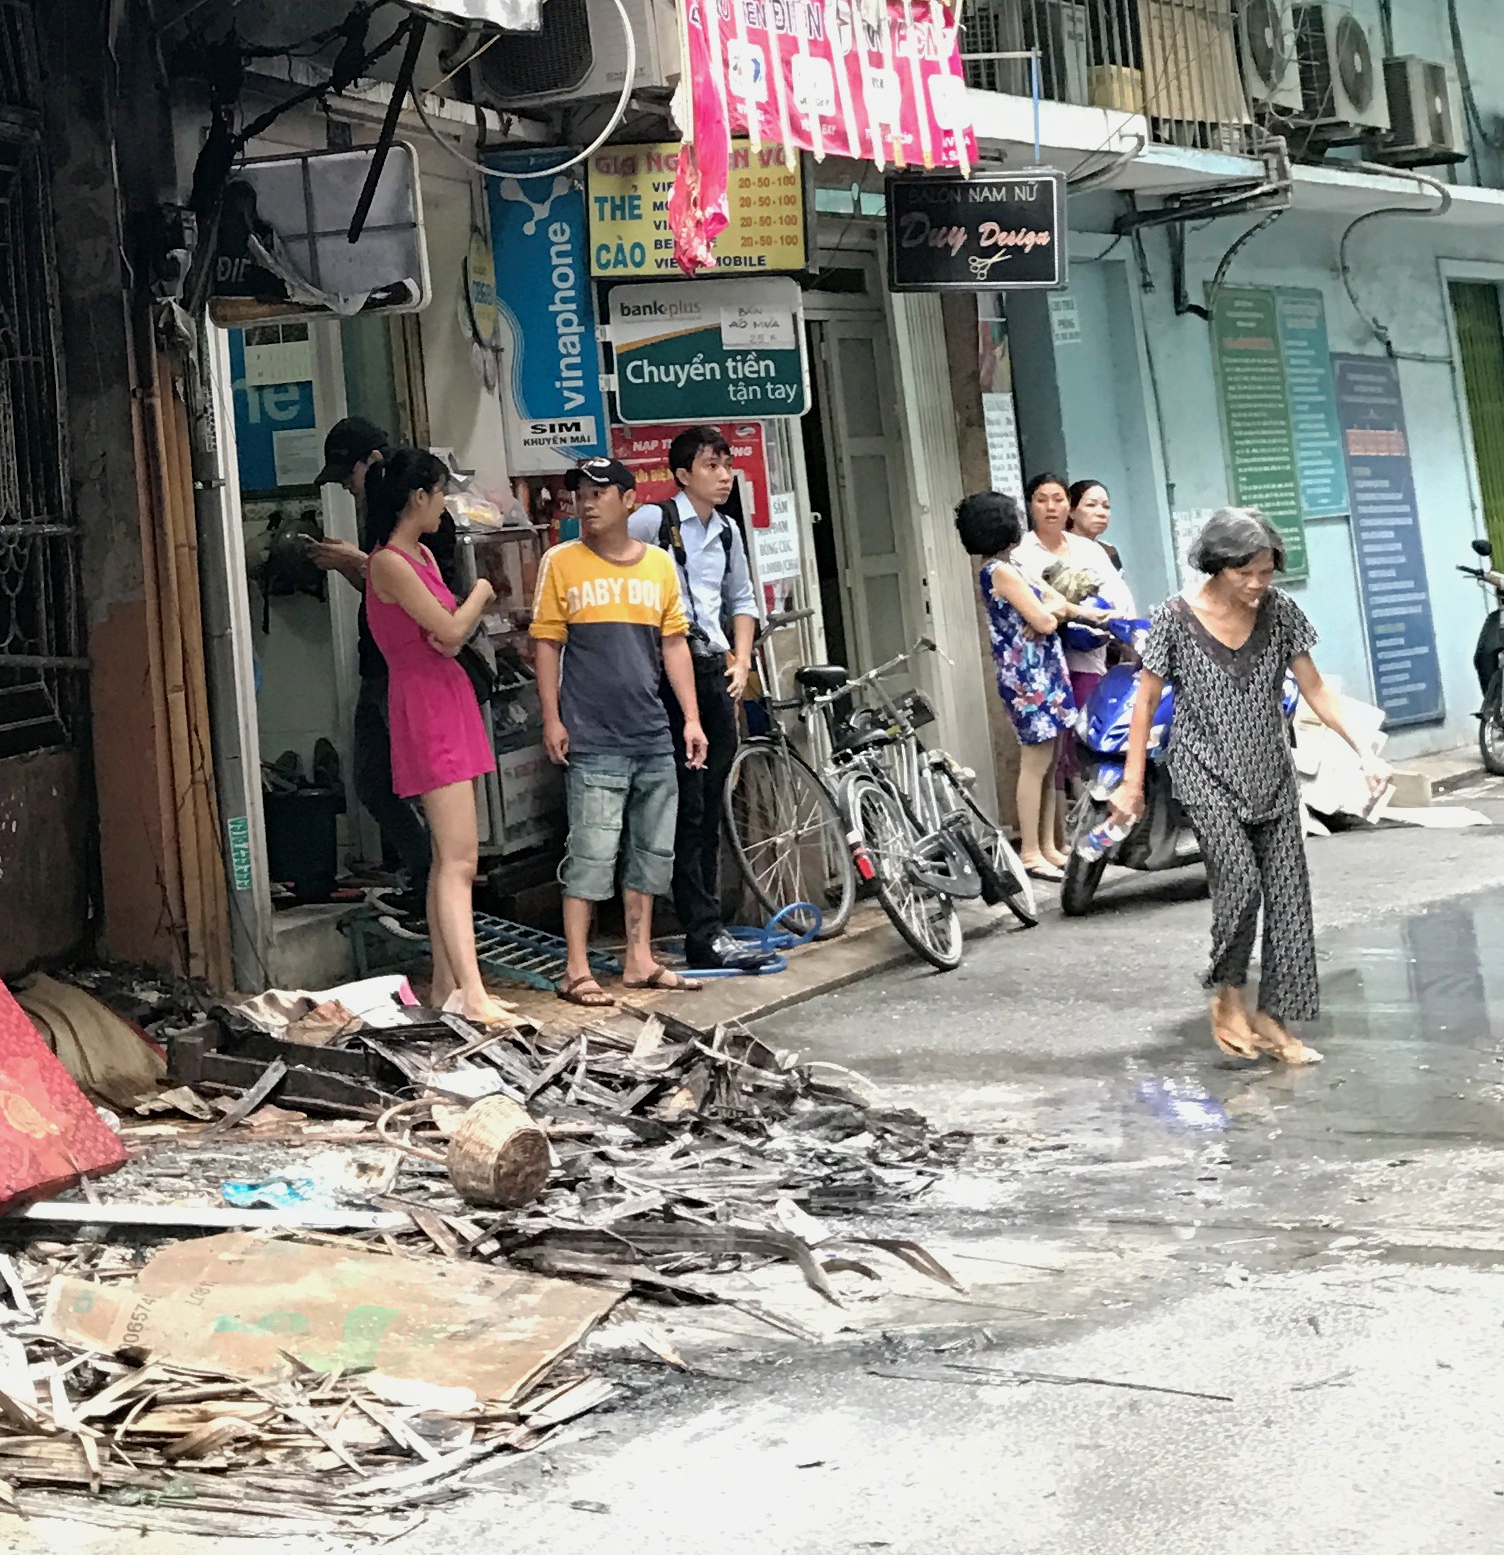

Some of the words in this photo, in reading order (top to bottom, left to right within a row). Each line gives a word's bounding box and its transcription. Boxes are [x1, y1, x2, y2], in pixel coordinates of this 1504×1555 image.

[594, 184, 643, 221] THẺ
[968, 186, 1007, 203] NAM
[1014, 180, 1038, 202] NỮ
[595, 234, 646, 271] CÀO
[899, 211, 969, 258] Duy
[978, 221, 1051, 254] Design
[548, 221, 586, 411] vinaphone
[626, 353, 721, 388] Chuyển
[725, 351, 776, 379] tiền
[727, 382, 761, 405] tận
[765, 383, 798, 404] tay
[531, 422, 582, 435] SIM
[632, 440, 659, 454] NẠP
